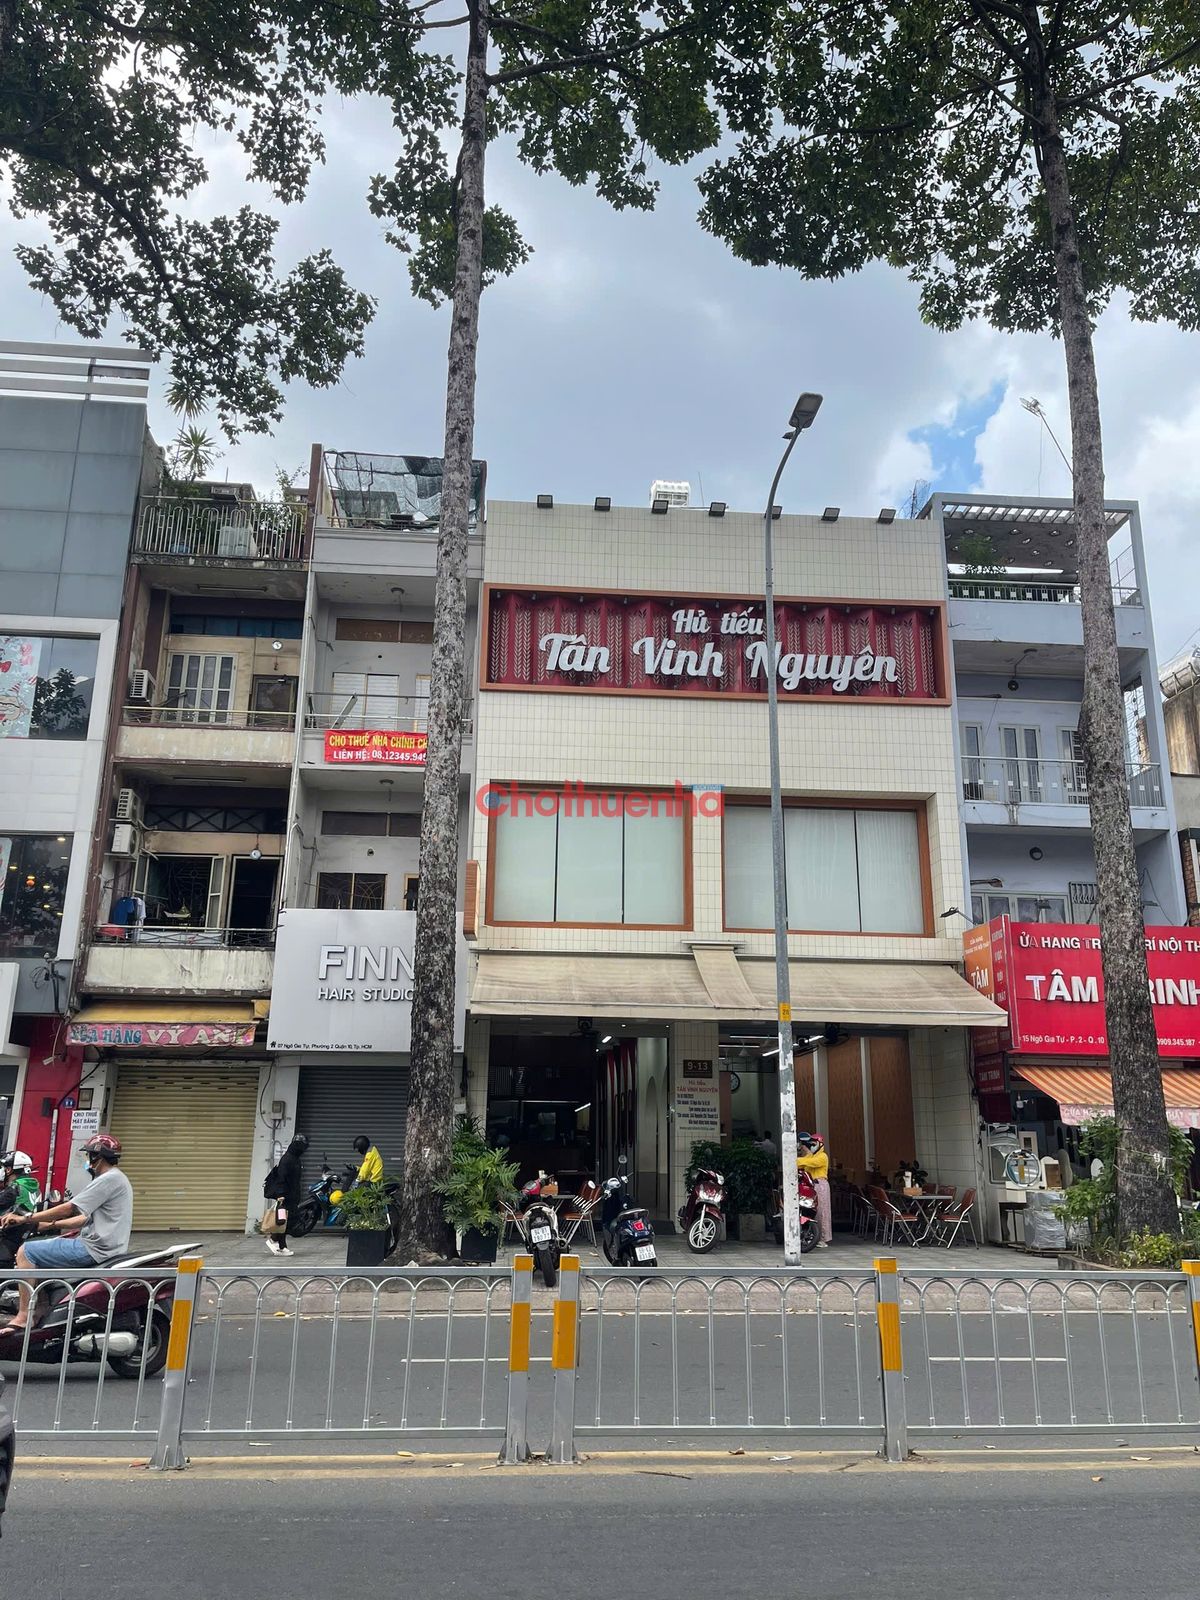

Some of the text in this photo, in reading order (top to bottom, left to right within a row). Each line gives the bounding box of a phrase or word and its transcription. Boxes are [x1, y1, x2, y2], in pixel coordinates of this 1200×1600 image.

[671, 606, 764, 635] Hủ tiếu
[539, 632, 899, 692] Tân Vinh Nguyên
[329, 732, 428, 749] CHO THUÊ NHÀ CHÍNH CH
[333, 748, 355, 760] LIÊN
[355, 748, 370, 761] HỆ:
[1083, 937, 1101, 950] TR
[1144, 936, 1156, 952] RÍ
[1158, 936, 1182, 954] NỘI
[1184, 940, 1200, 952] TH
[318, 944, 416, 981] FINN
[971, 965, 989, 989] TÂM
[1025, 968, 1100, 1003] TÂM
[318, 987, 355, 1001] HAIR
[102, 1026, 142, 1044] HÀNG
[1188, 1111, 1200, 1127] T
